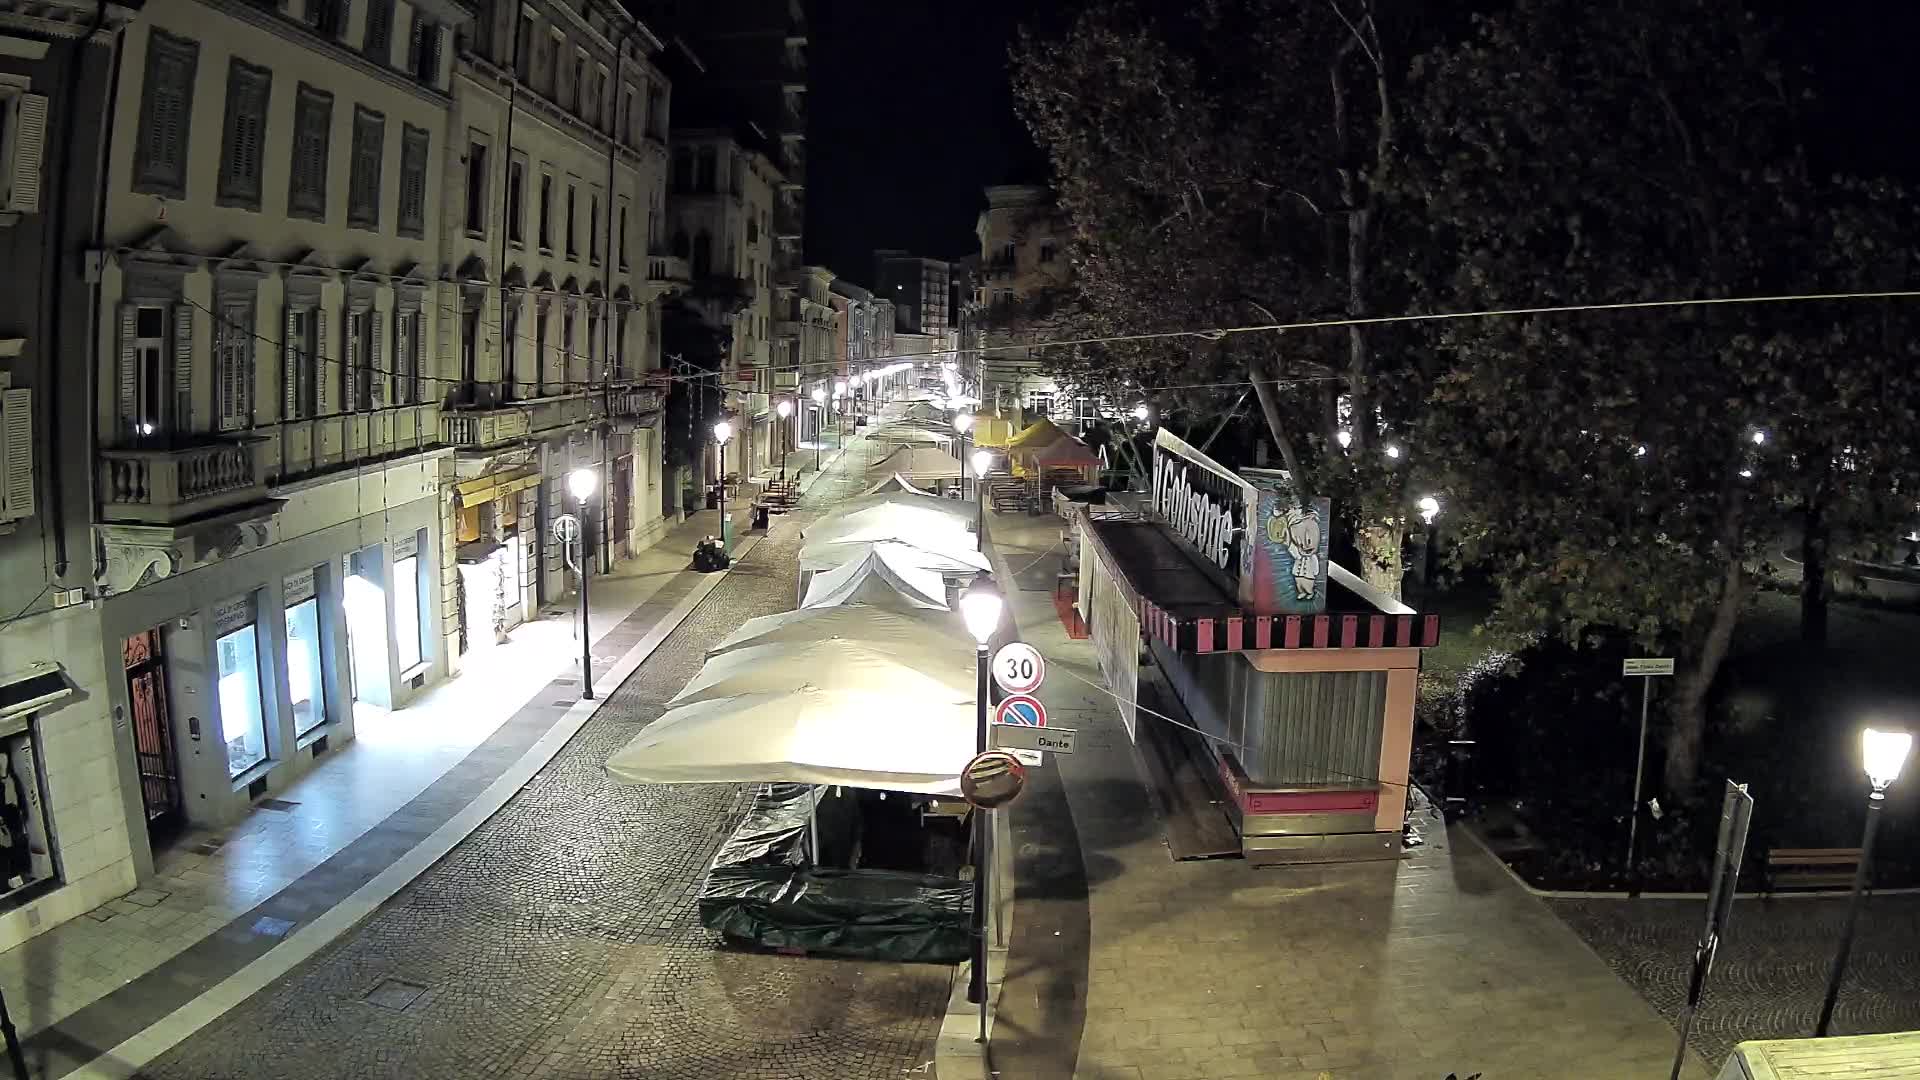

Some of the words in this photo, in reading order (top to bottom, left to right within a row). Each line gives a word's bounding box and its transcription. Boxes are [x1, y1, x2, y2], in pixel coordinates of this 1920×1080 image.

[1162, 458, 1233, 569] Golosone
[1007, 659, 1033, 680] 30
[1038, 737, 1070, 750] Dante
